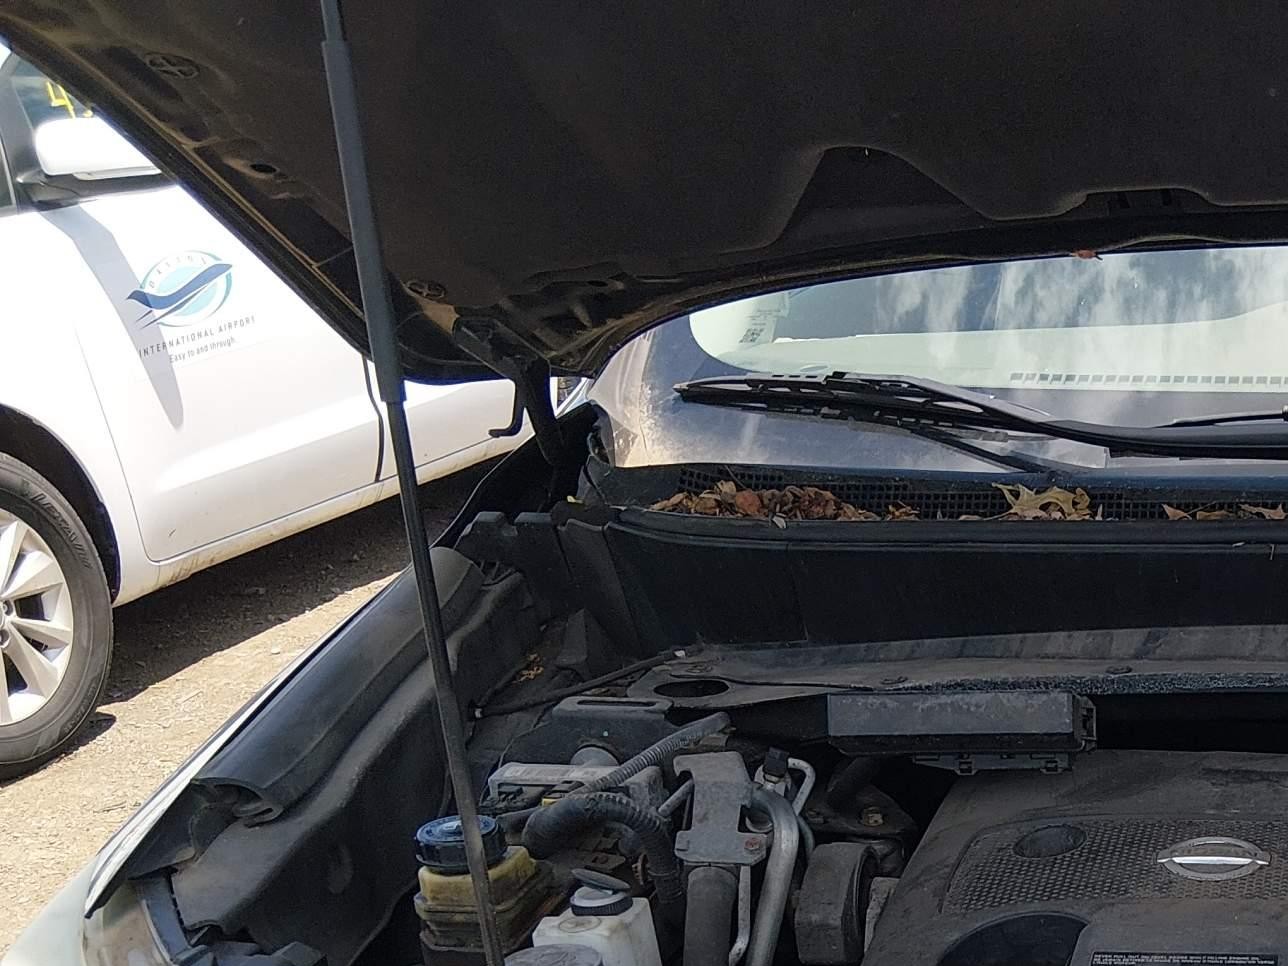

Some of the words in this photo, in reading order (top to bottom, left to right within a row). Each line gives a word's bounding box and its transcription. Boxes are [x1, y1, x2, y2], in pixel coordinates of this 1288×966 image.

[139, 329, 215, 358] INTERNATIONAL
[218, 315, 256, 333] AIRPORT
[169, 350, 187, 363] Easy
